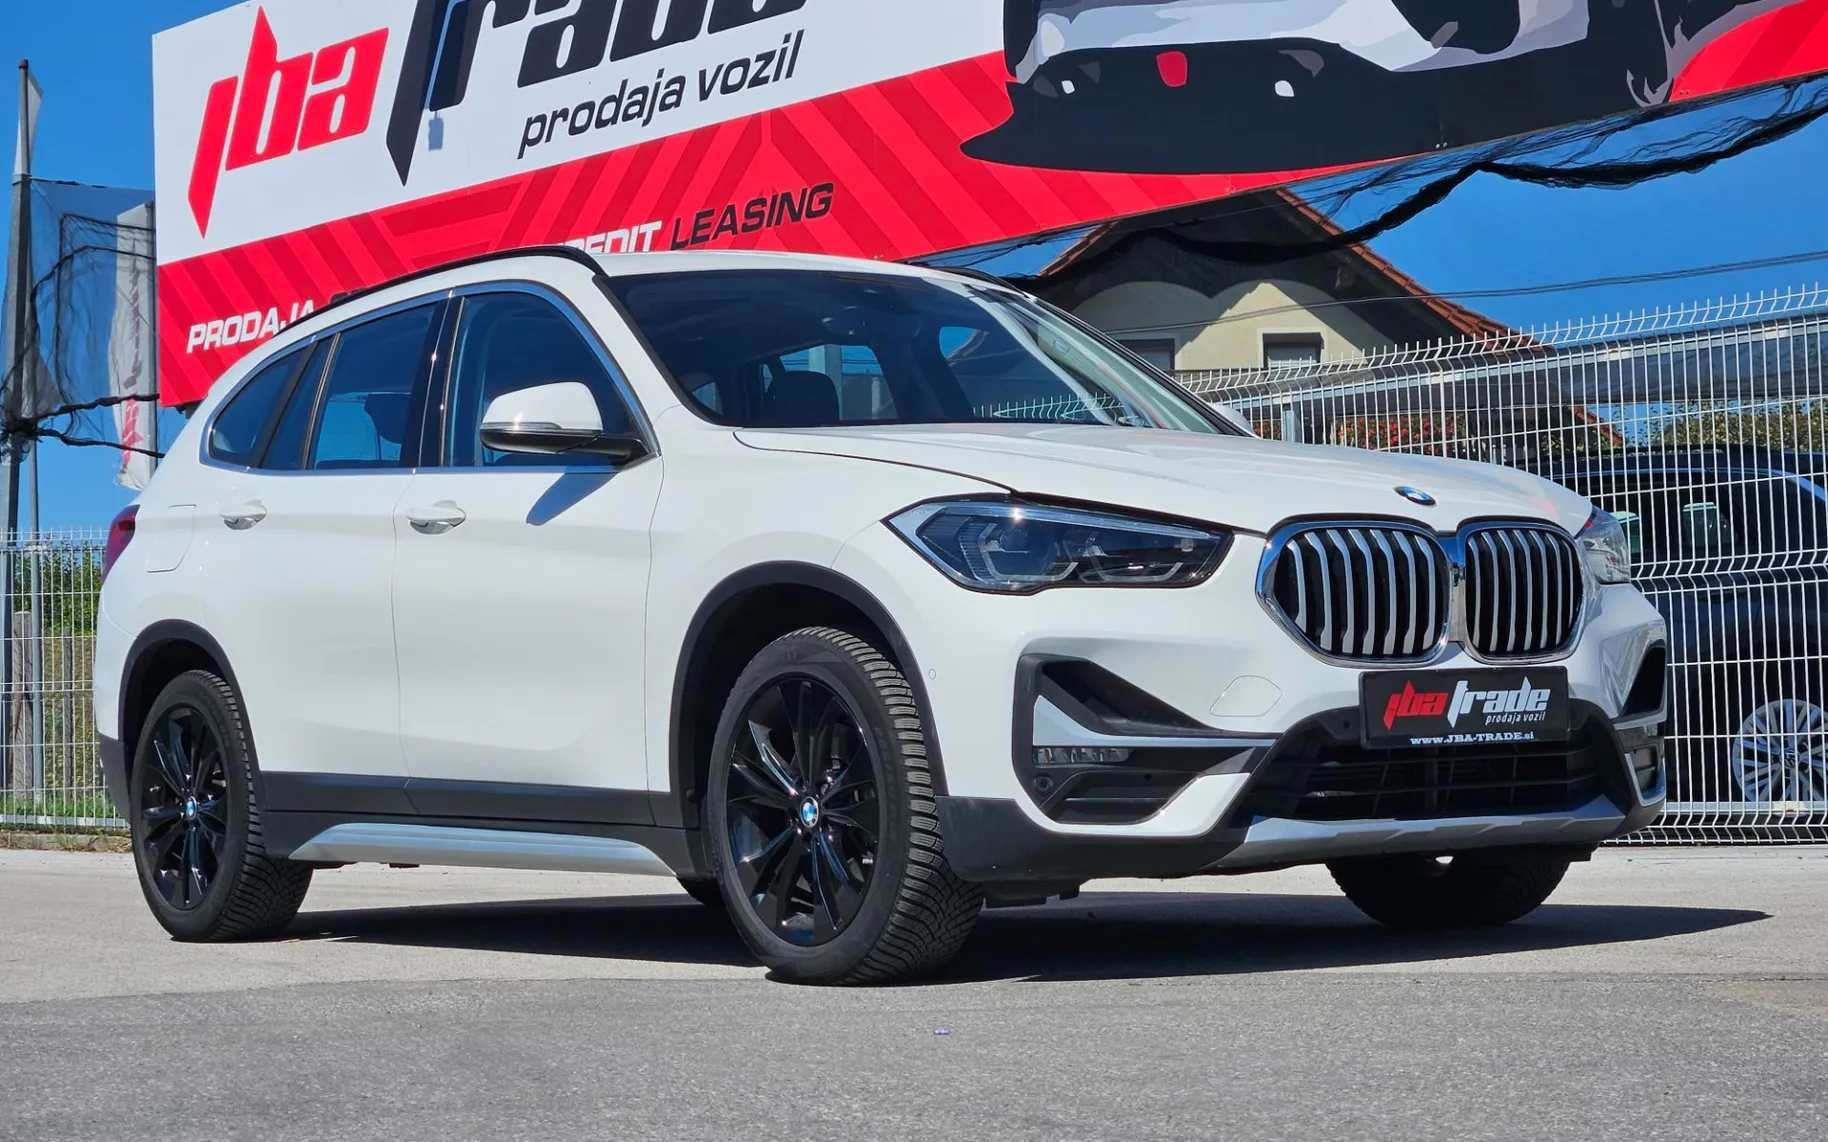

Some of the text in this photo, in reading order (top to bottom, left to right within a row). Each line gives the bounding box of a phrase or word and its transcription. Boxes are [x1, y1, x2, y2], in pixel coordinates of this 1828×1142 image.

[386, 0, 807, 186] tra
[517, 29, 805, 160] prodaja vozil
[669, 182, 834, 251] LEASING
[1447, 676, 1551, 728] trade
[1485, 711, 1546, 726] prodaja vozil
[1410, 731, 1535, 745] www.JBA-TRADE.si
